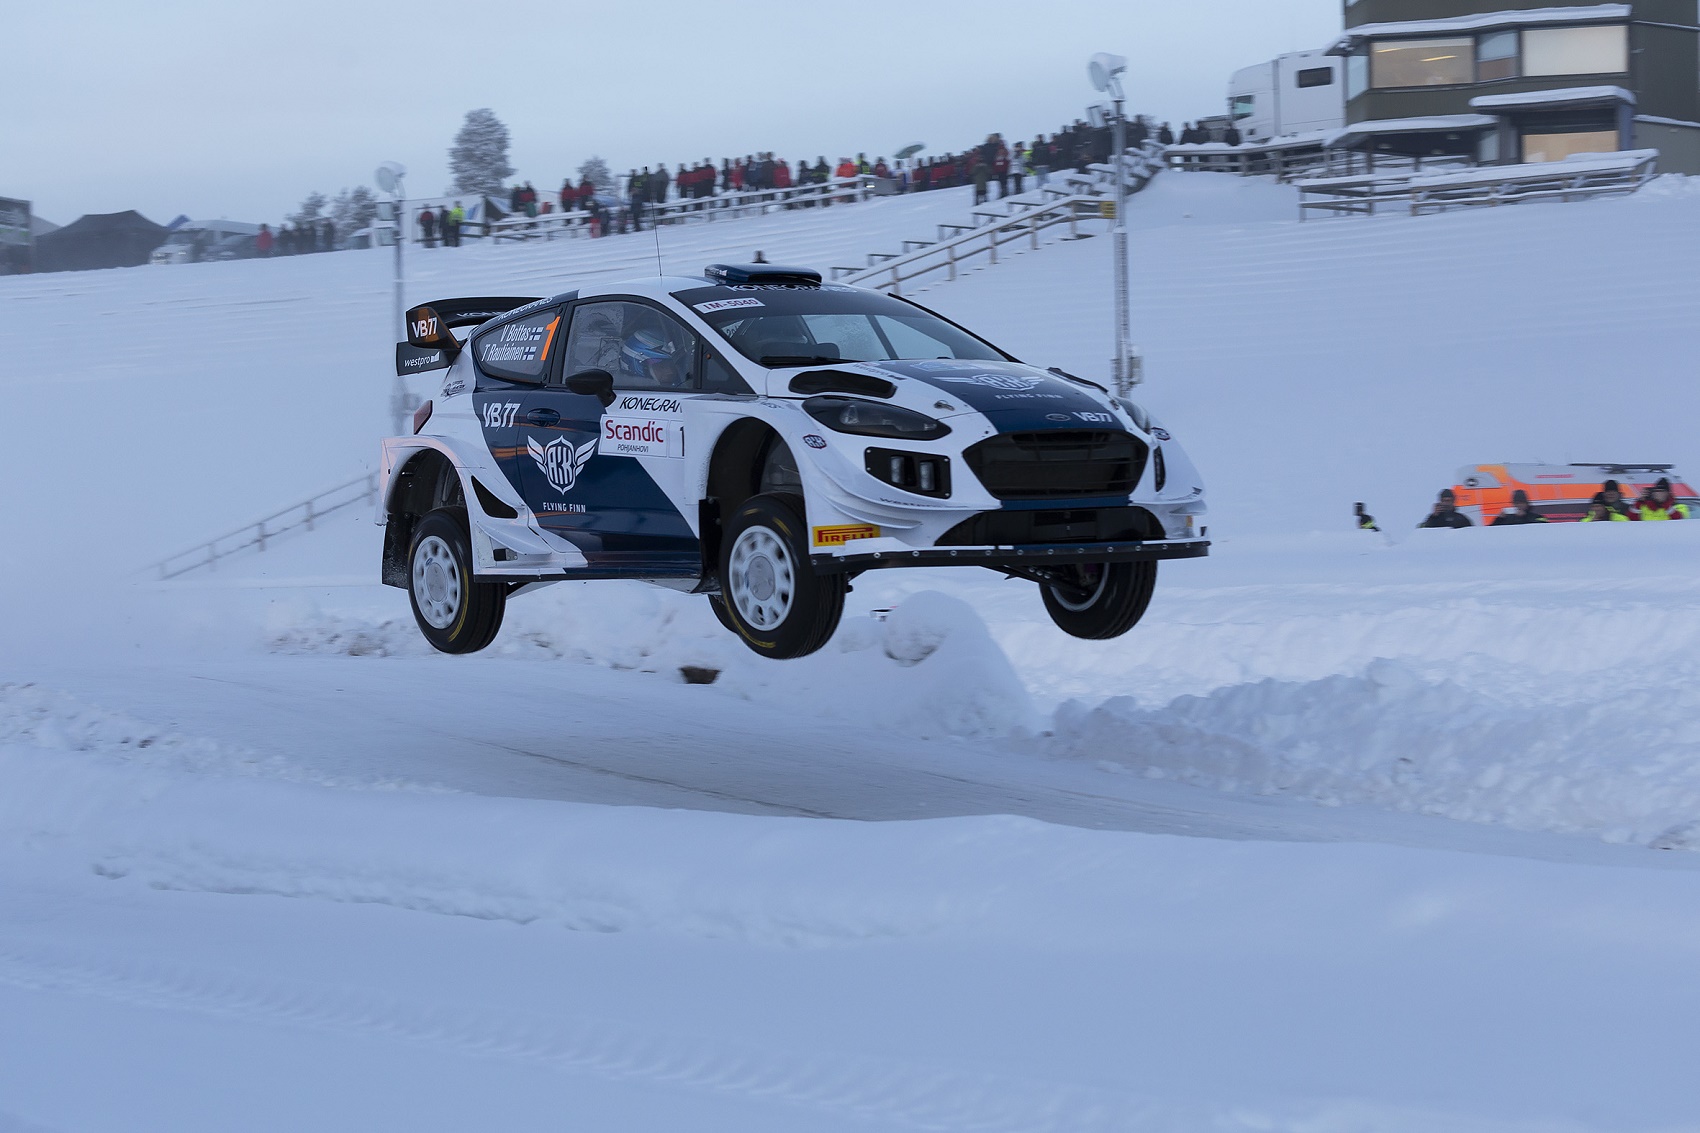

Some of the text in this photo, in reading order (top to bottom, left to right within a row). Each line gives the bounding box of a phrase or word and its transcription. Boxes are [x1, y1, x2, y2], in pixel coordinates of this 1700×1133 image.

[500, 324, 531, 342] V Bottas
[540, 316, 561, 361] 1
[404, 353, 431, 367] westpro
[481, 343, 525, 361] T Rautiainen
[605, 419, 664, 443] Scandic
[617, 444, 650, 454] POHJANHOVI
[679, 426, 685, 457] 1
[542, 502, 586, 513] FLYING FINN
[817, 527, 874, 543] PIRELLI
